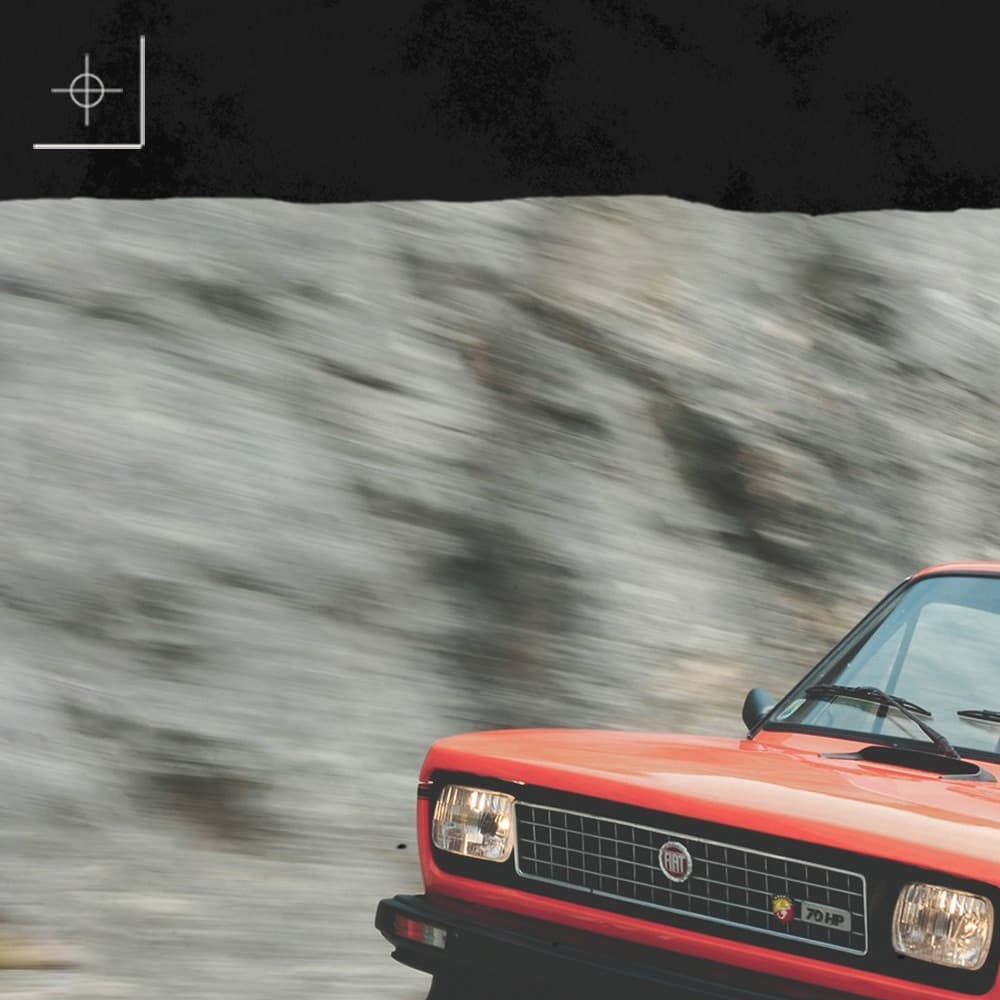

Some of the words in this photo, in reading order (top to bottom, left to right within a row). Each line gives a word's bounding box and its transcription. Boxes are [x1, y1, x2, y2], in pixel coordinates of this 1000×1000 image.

[664, 849, 686, 873] FIAT
[806, 907, 821, 921] 70
[824, 911, 845, 927] HP
